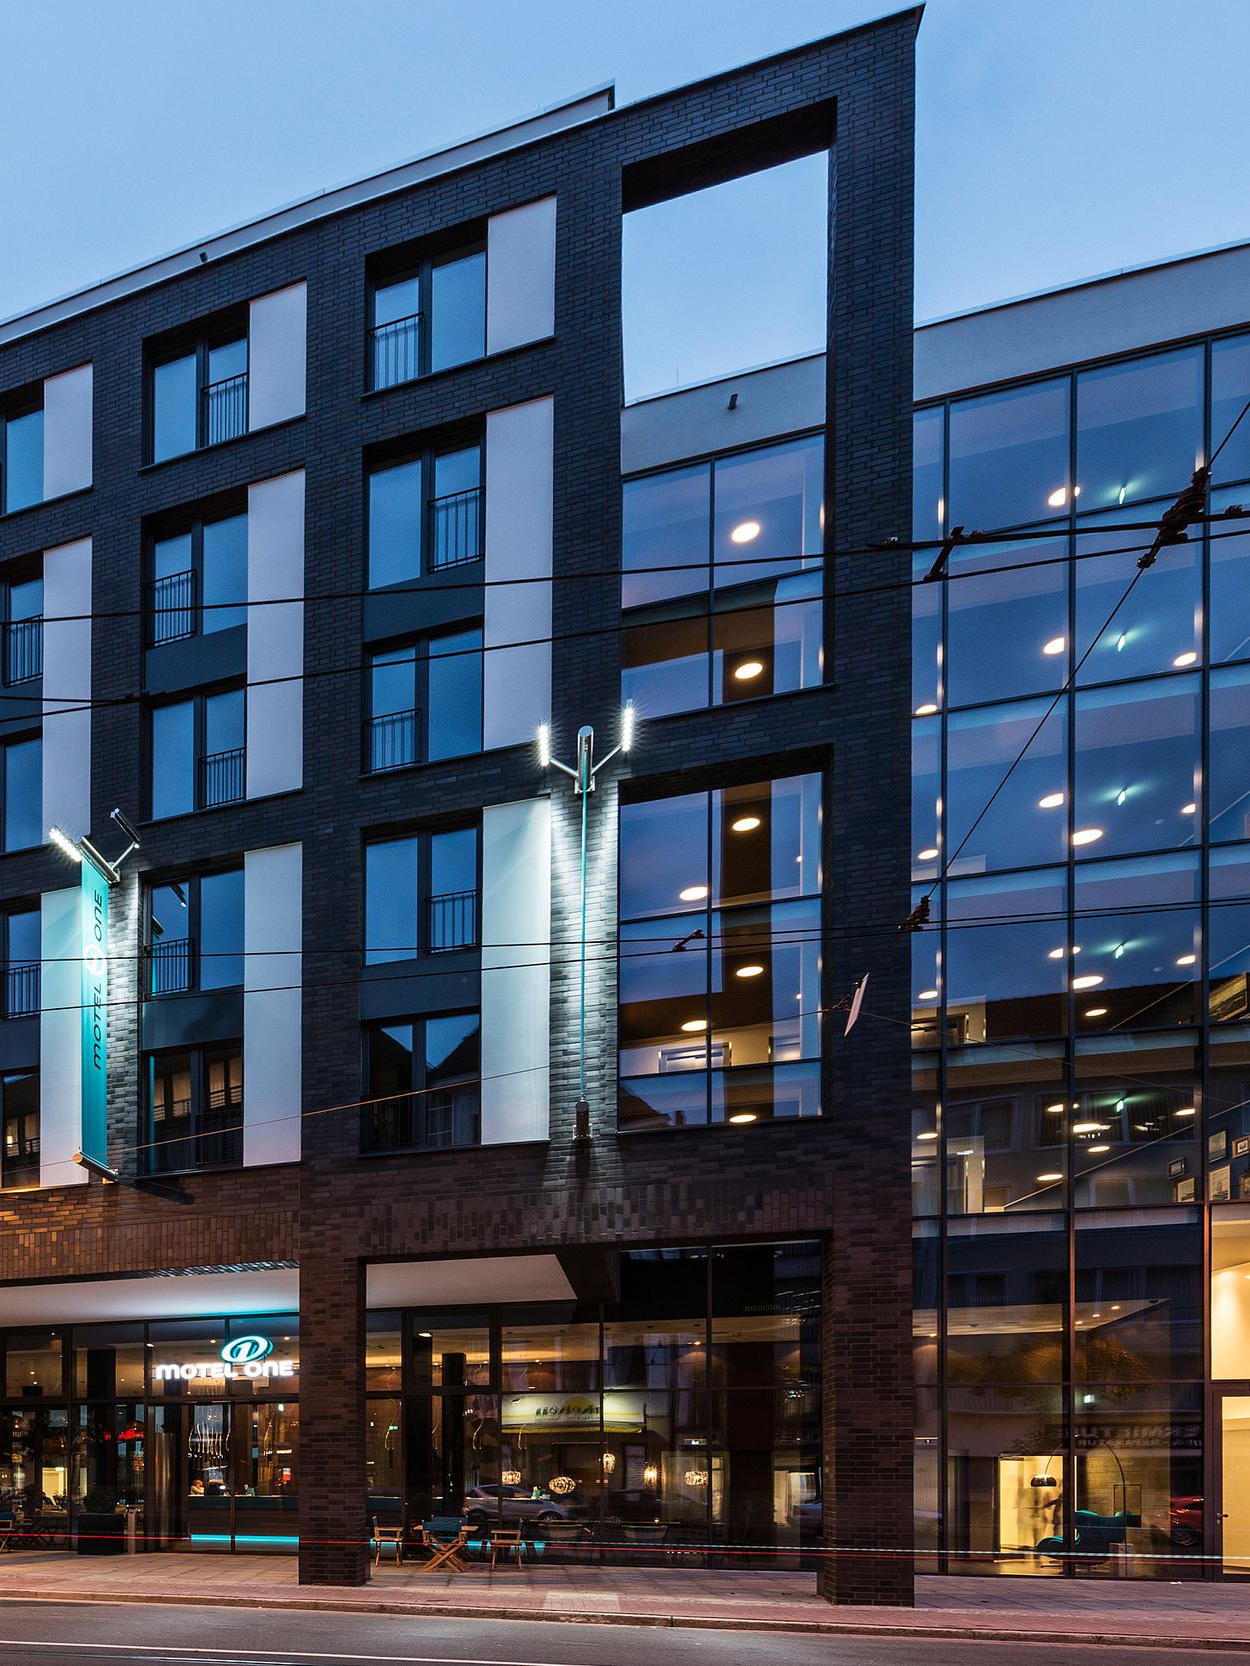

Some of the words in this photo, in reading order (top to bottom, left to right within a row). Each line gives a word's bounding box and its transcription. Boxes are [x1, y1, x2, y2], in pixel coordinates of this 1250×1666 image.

[93, 890, 103, 942] ONE
[155, 1362, 239, 1380] MOTEL
[244, 1360, 295, 1377] ONE
